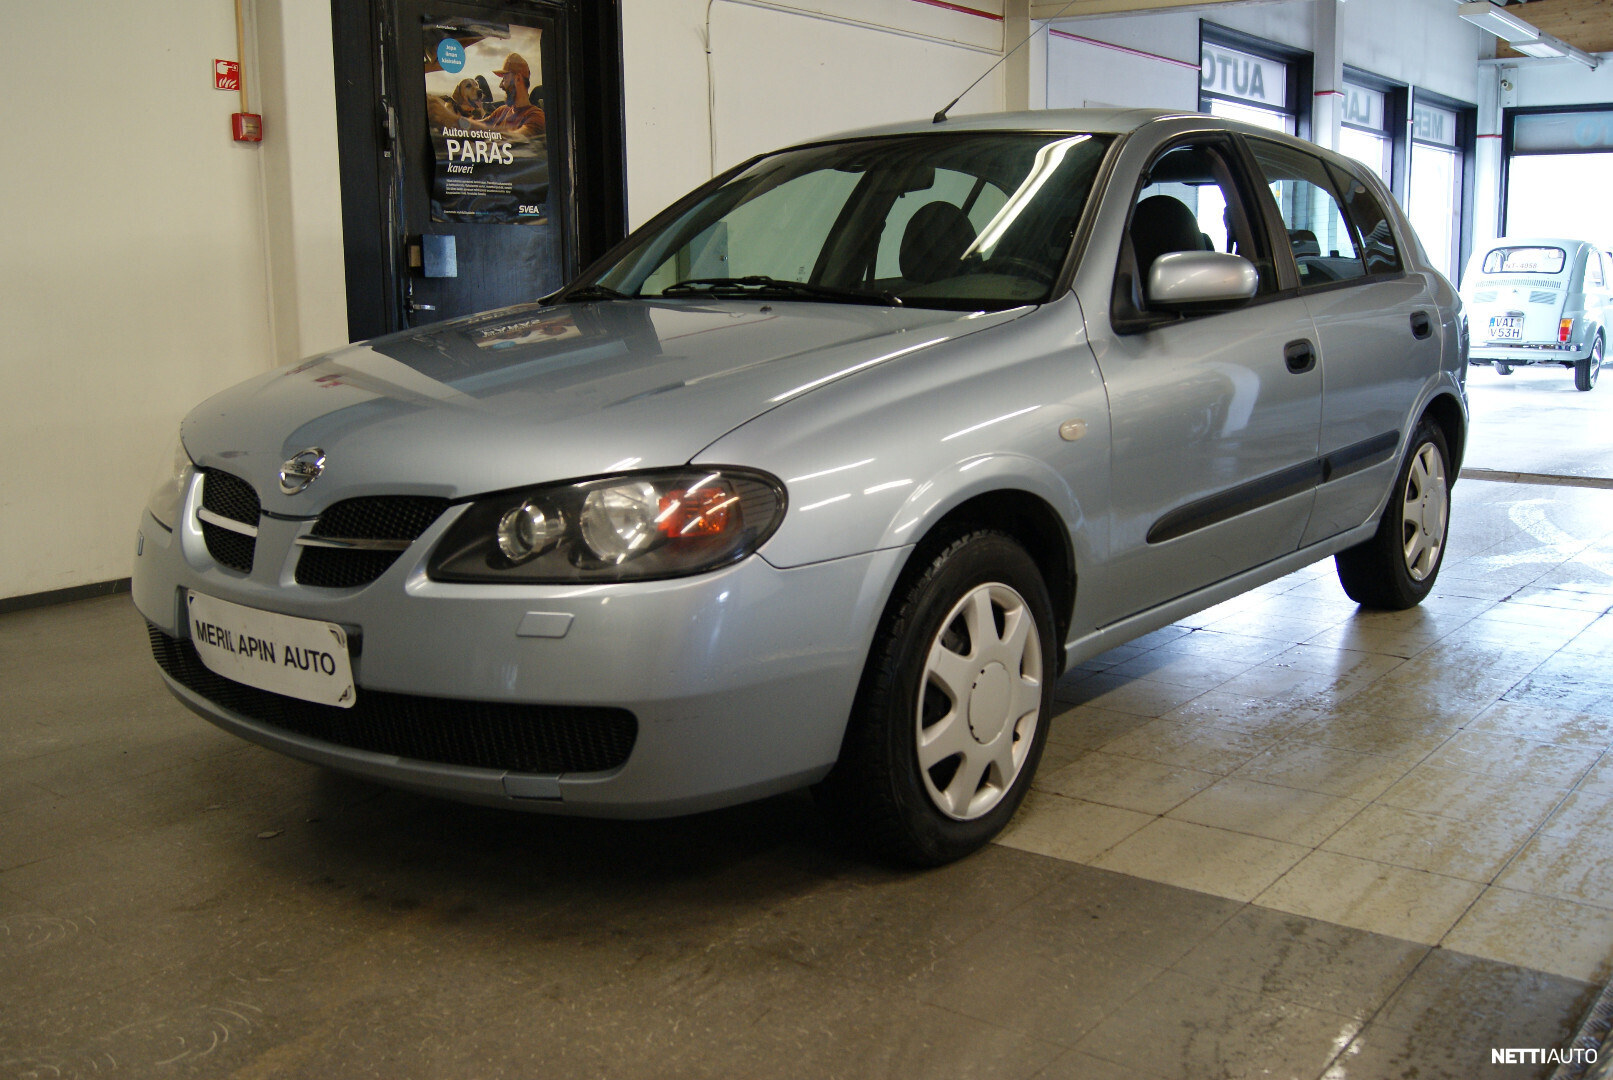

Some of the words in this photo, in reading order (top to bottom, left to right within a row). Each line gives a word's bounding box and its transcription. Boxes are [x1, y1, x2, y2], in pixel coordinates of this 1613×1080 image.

[443, 126, 469, 138] Auton
[471, 129, 502, 141] ostajan
[446, 139, 514, 165] PARAS
[447, 162, 474, 174] kaveri
[519, 205, 539, 214] SVEA
[1490, 328, 1520, 338] V53H
[284, 645, 336, 676] AUTO
